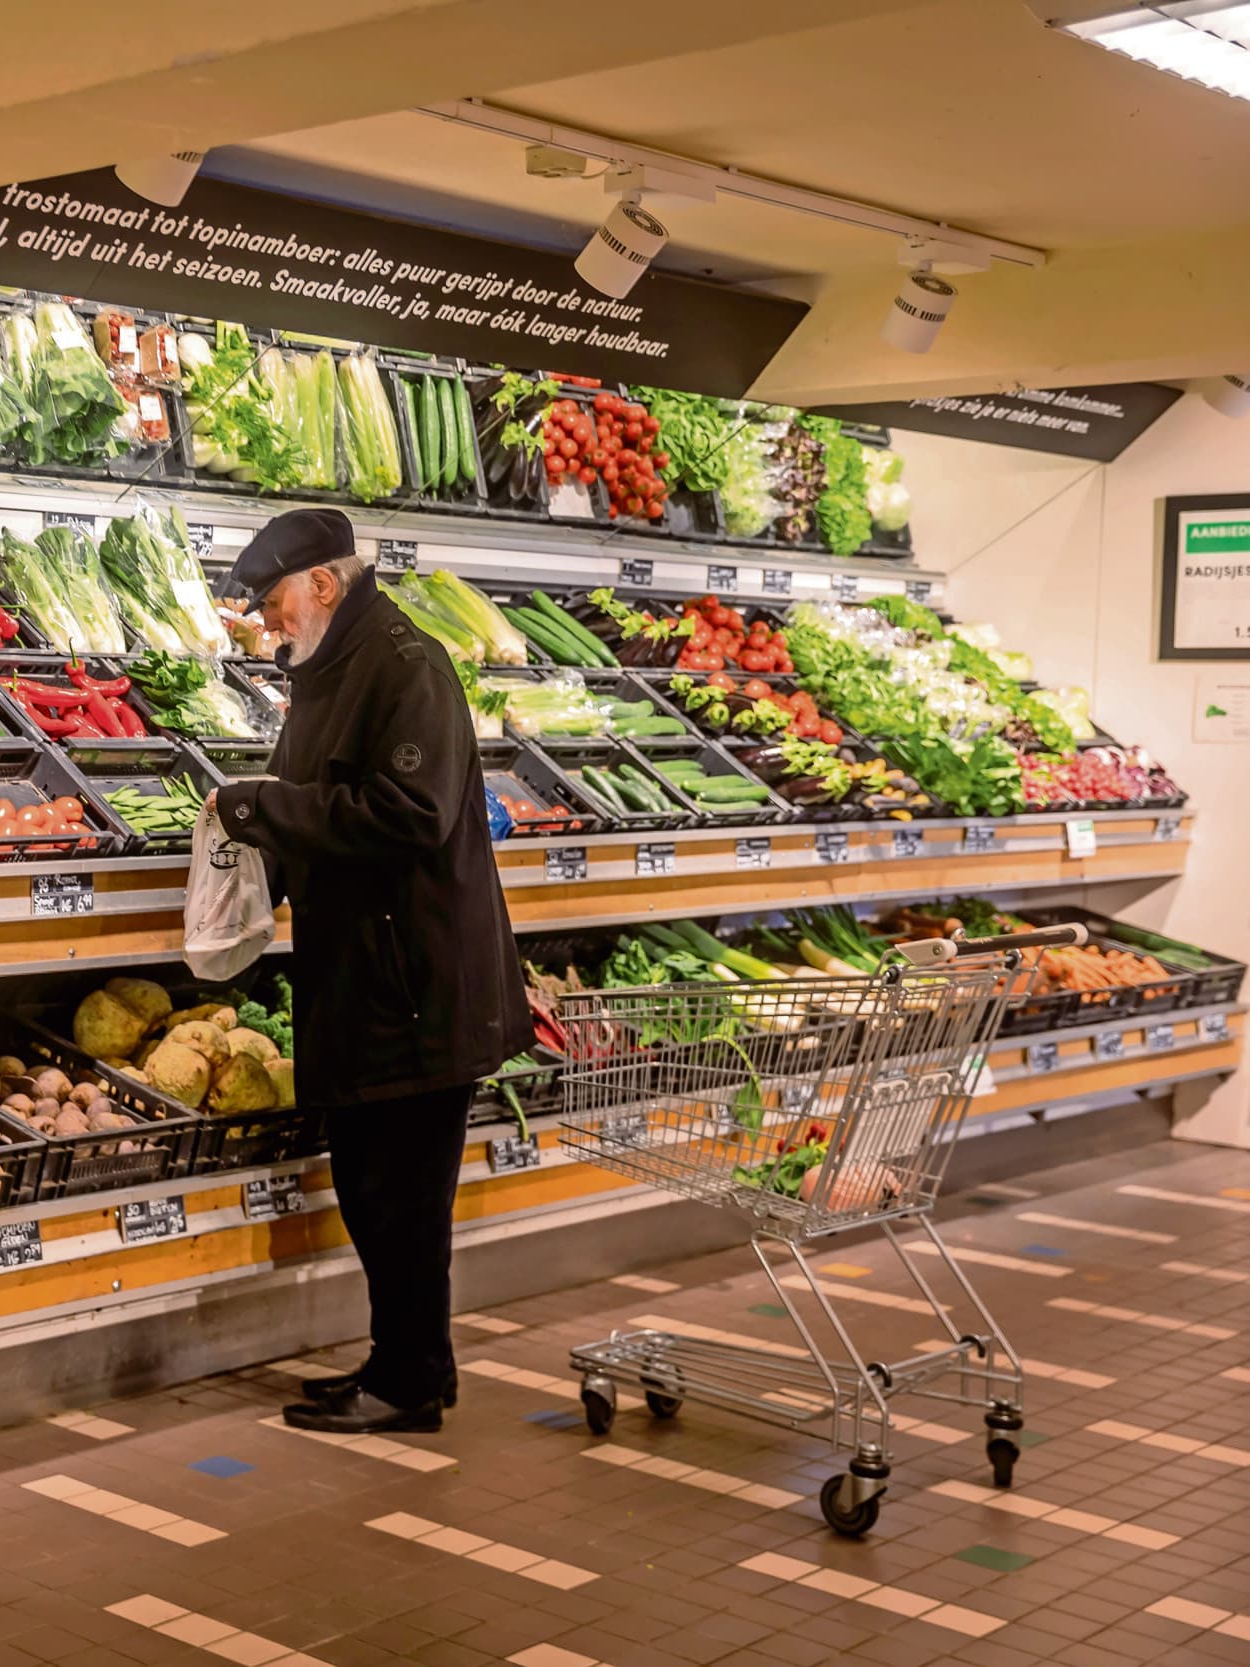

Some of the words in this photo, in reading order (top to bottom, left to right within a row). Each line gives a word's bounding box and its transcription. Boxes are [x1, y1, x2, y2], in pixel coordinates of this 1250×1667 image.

[2, 182, 150, 230] trostomaat
[150, 211, 189, 237] tot
[188, 218, 341, 266] topinamboer:
[343, 248, 394, 276] alles
[391, 262, 447, 284] puur
[441, 271, 514, 301] gerijpt
[511, 280, 558, 306] door
[556, 288, 583, 311] de
[581, 299, 643, 323] natuur.
[17, 226, 92, 261] altijd
[90, 238, 128, 264] uit
[128, 242, 173, 271] het
[172, 255, 263, 289] seizoen.
[269, 269, 403, 315] Smaakvoller,
[399, 293, 431, 320] ja,
[434, 303, 491, 326] maar
[489, 308, 527, 333] óók
[524, 314, 587, 345] langer
[584, 324, 670, 358] houdbaar.
